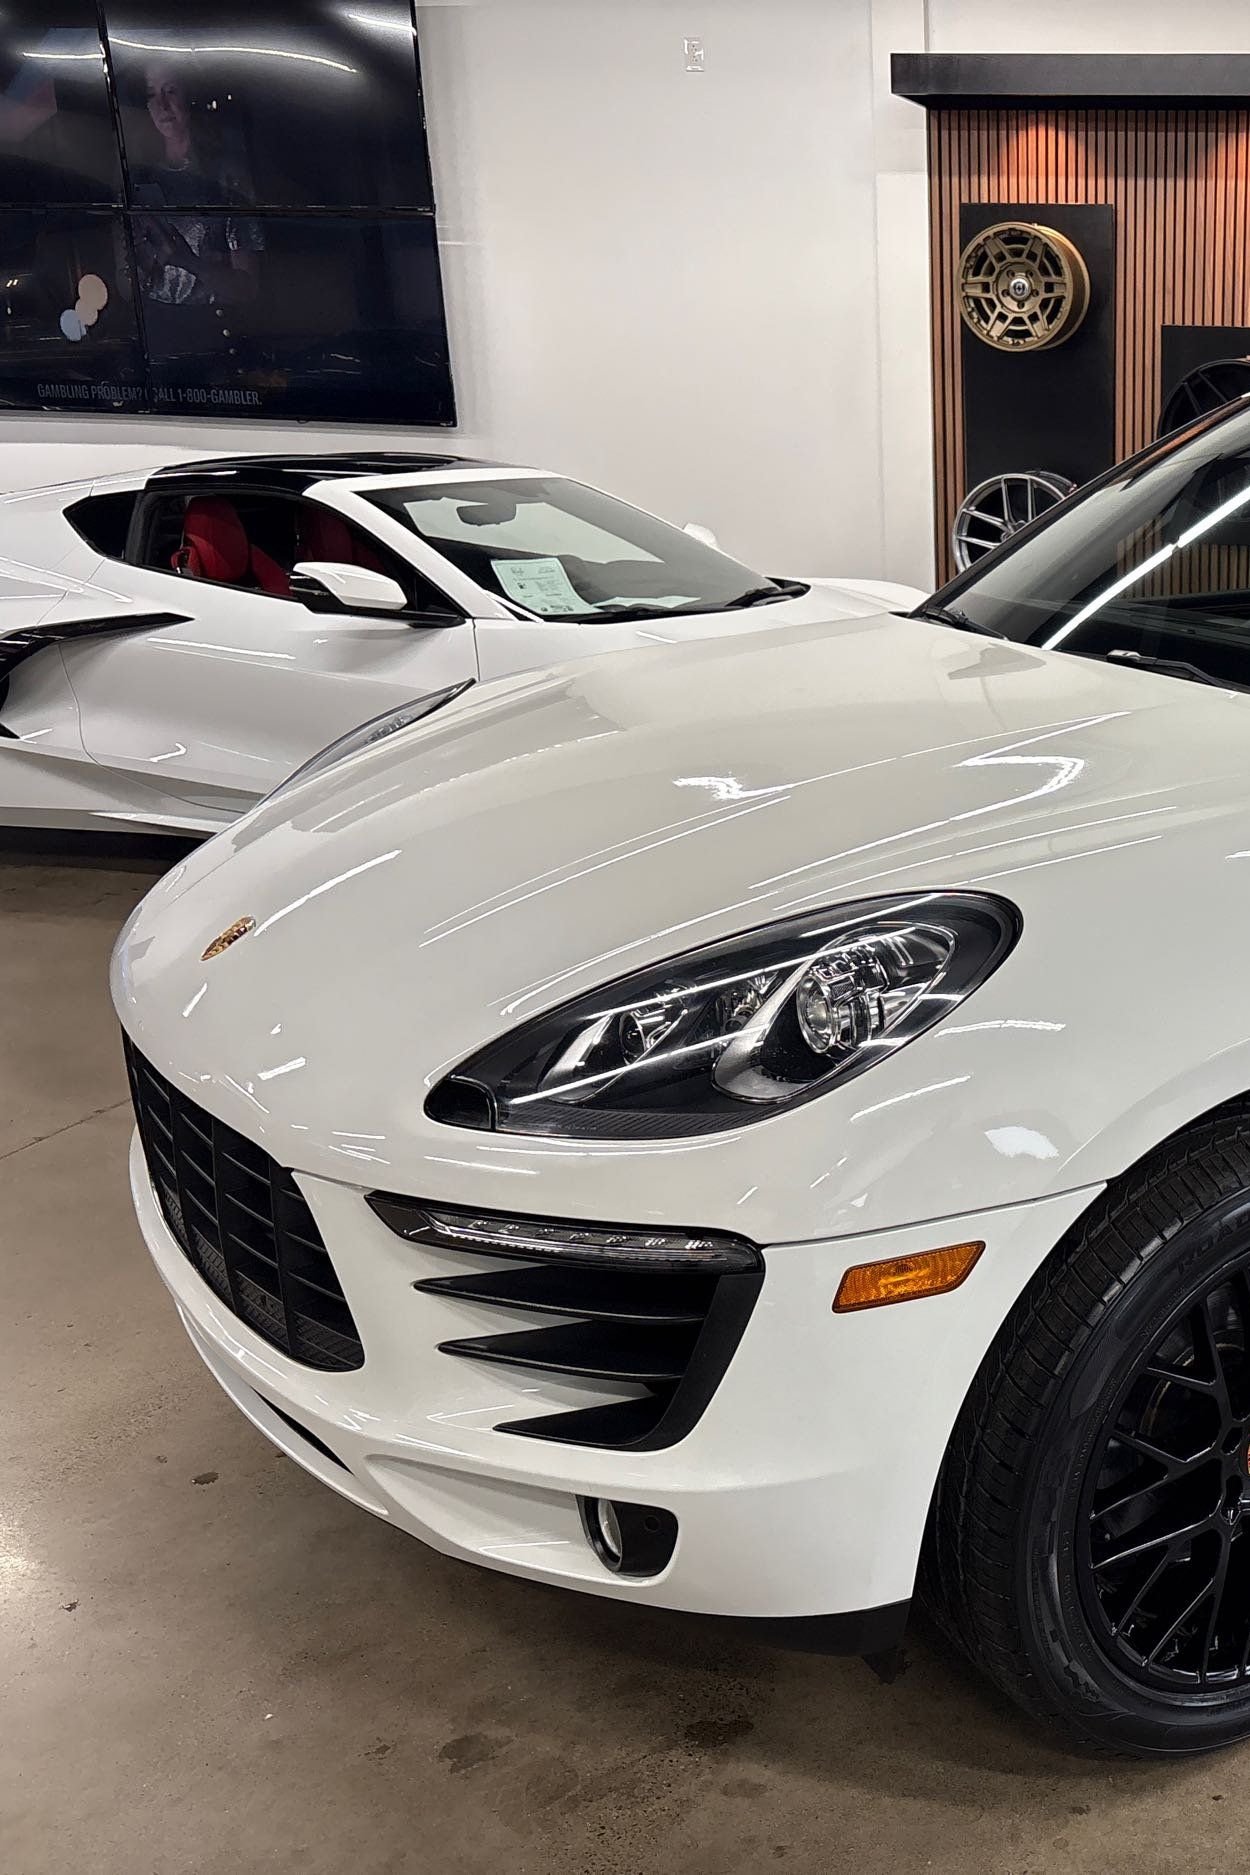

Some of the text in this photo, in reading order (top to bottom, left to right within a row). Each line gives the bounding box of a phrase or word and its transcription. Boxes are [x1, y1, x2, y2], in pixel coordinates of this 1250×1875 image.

[37, 383, 90, 399] GAMBLING
[91, 385, 143, 400] PROBLEM?
[177, 388, 263, 405] 1-800-GAMBLER.
